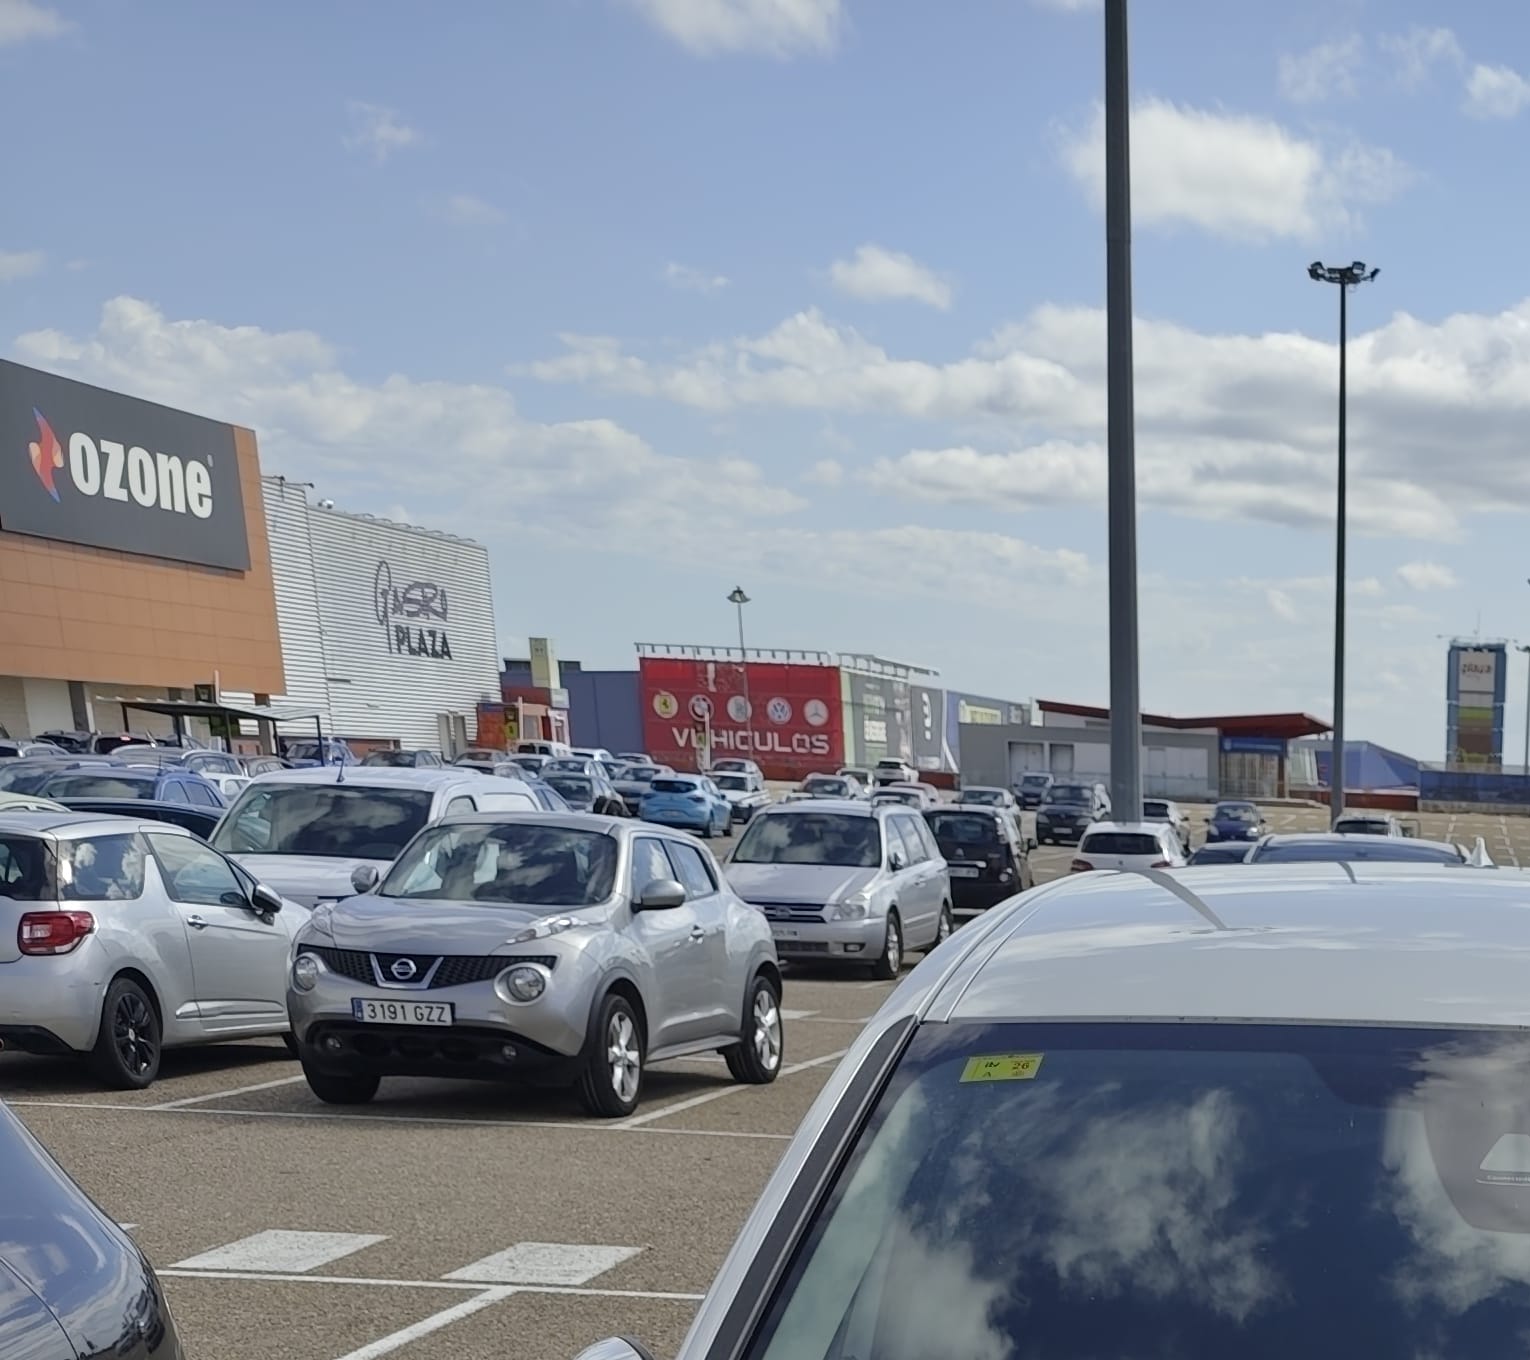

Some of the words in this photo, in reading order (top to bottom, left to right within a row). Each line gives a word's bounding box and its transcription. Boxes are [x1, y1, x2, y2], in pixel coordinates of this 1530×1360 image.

[69, 432, 213, 519] ozone
[394, 624, 453, 660] PLAZA
[367, 1003, 407, 1021] 3191
[414, 1005, 447, 1023] GZZ
